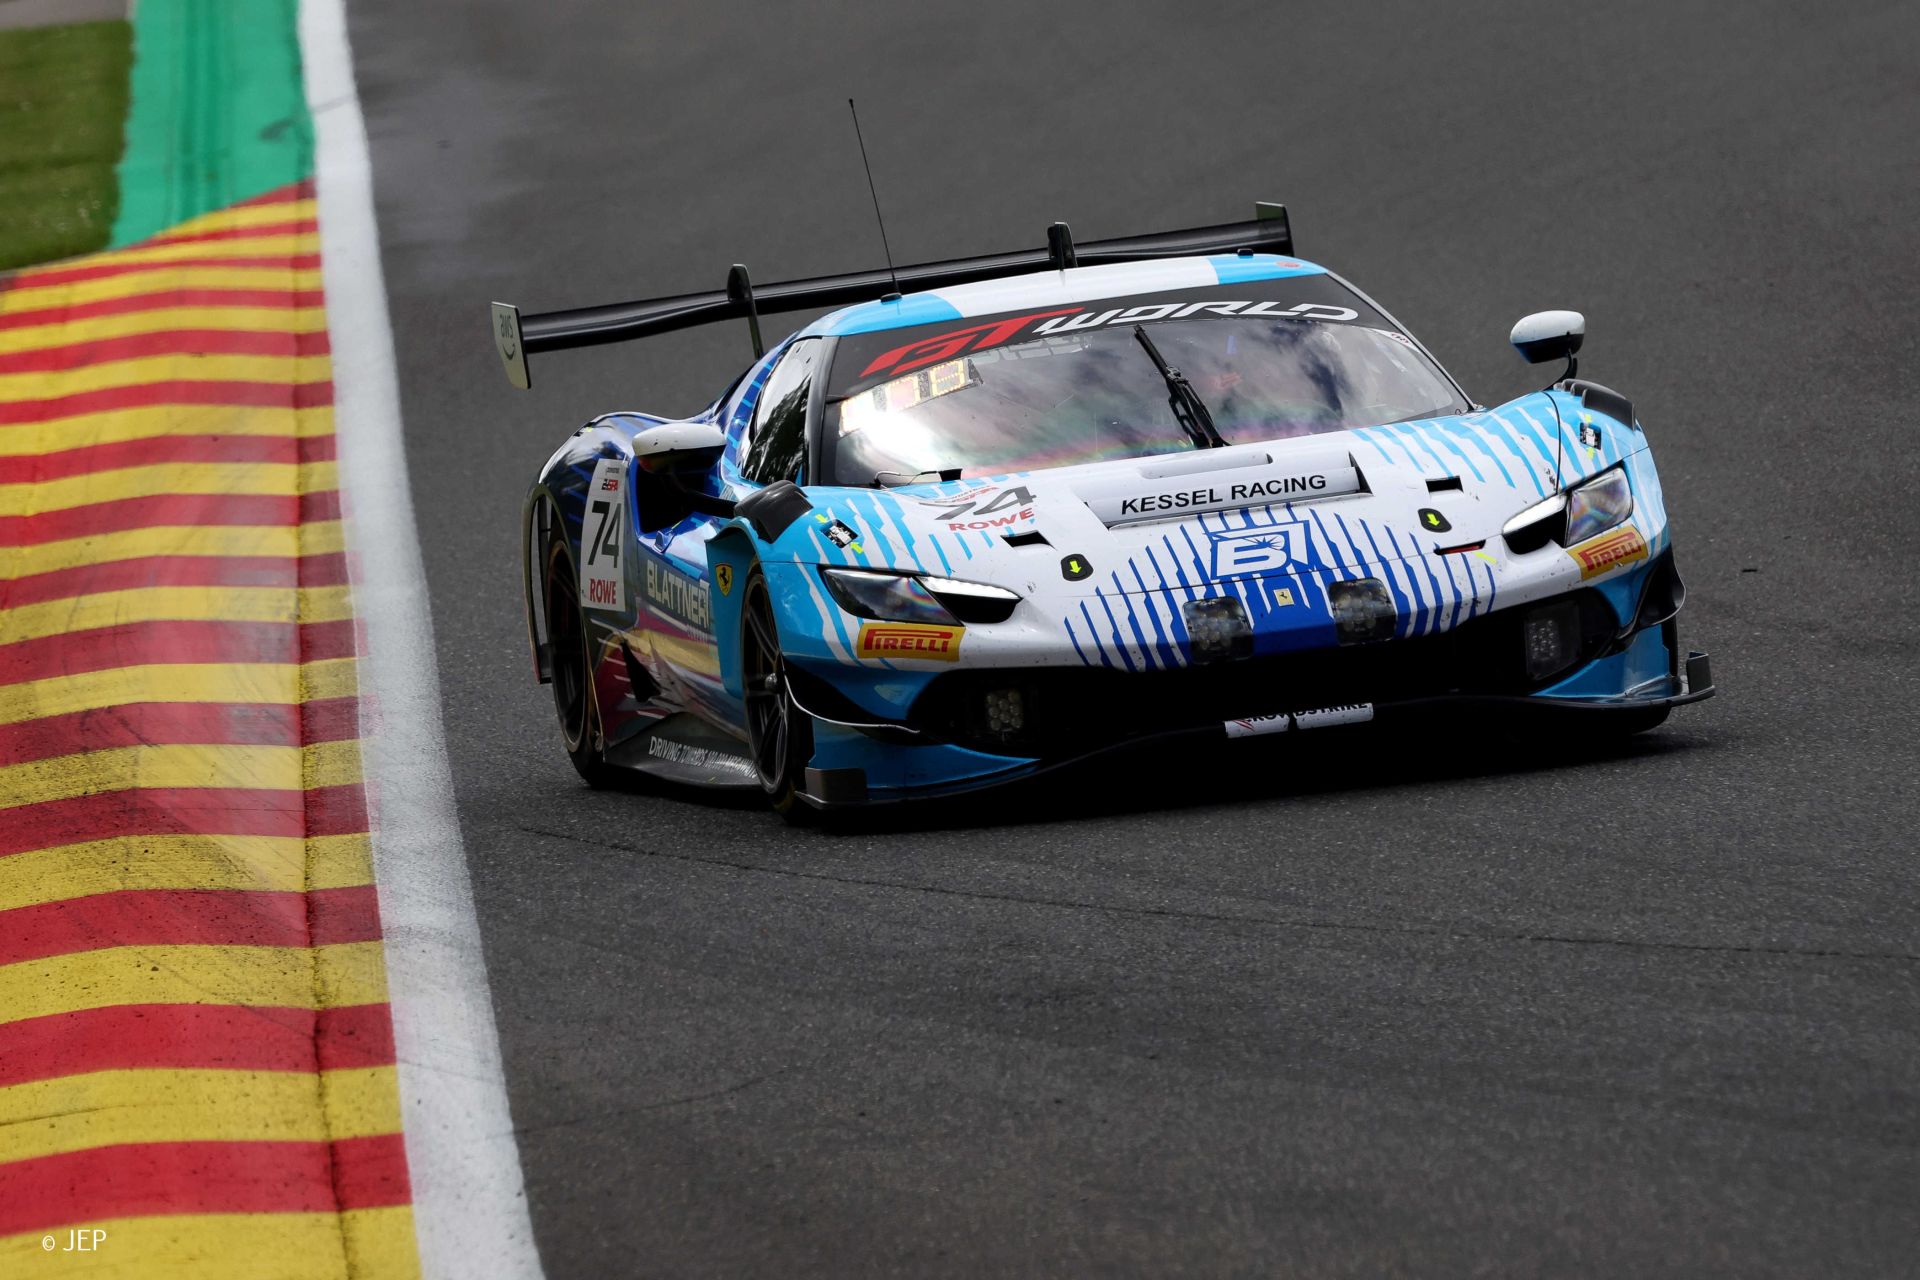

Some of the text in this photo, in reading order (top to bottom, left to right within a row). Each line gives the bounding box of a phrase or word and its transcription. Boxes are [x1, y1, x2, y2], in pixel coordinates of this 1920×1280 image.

[500, 314, 514, 339] aws
[860, 301, 1359, 378] GT WORLD
[919, 486, 1037, 520] 74
[1121, 475, 1327, 515] KESSEL RACING
[588, 501, 621, 568] 74
[948, 508, 1035, 531] ROWE
[1578, 532, 1642, 571] PIRELLI
[590, 579, 617, 604] ROWE
[647, 560, 710, 628] BLATTNER
[864, 629, 953, 653] PIRELLI
[649, 736, 682, 762] DRIVING
